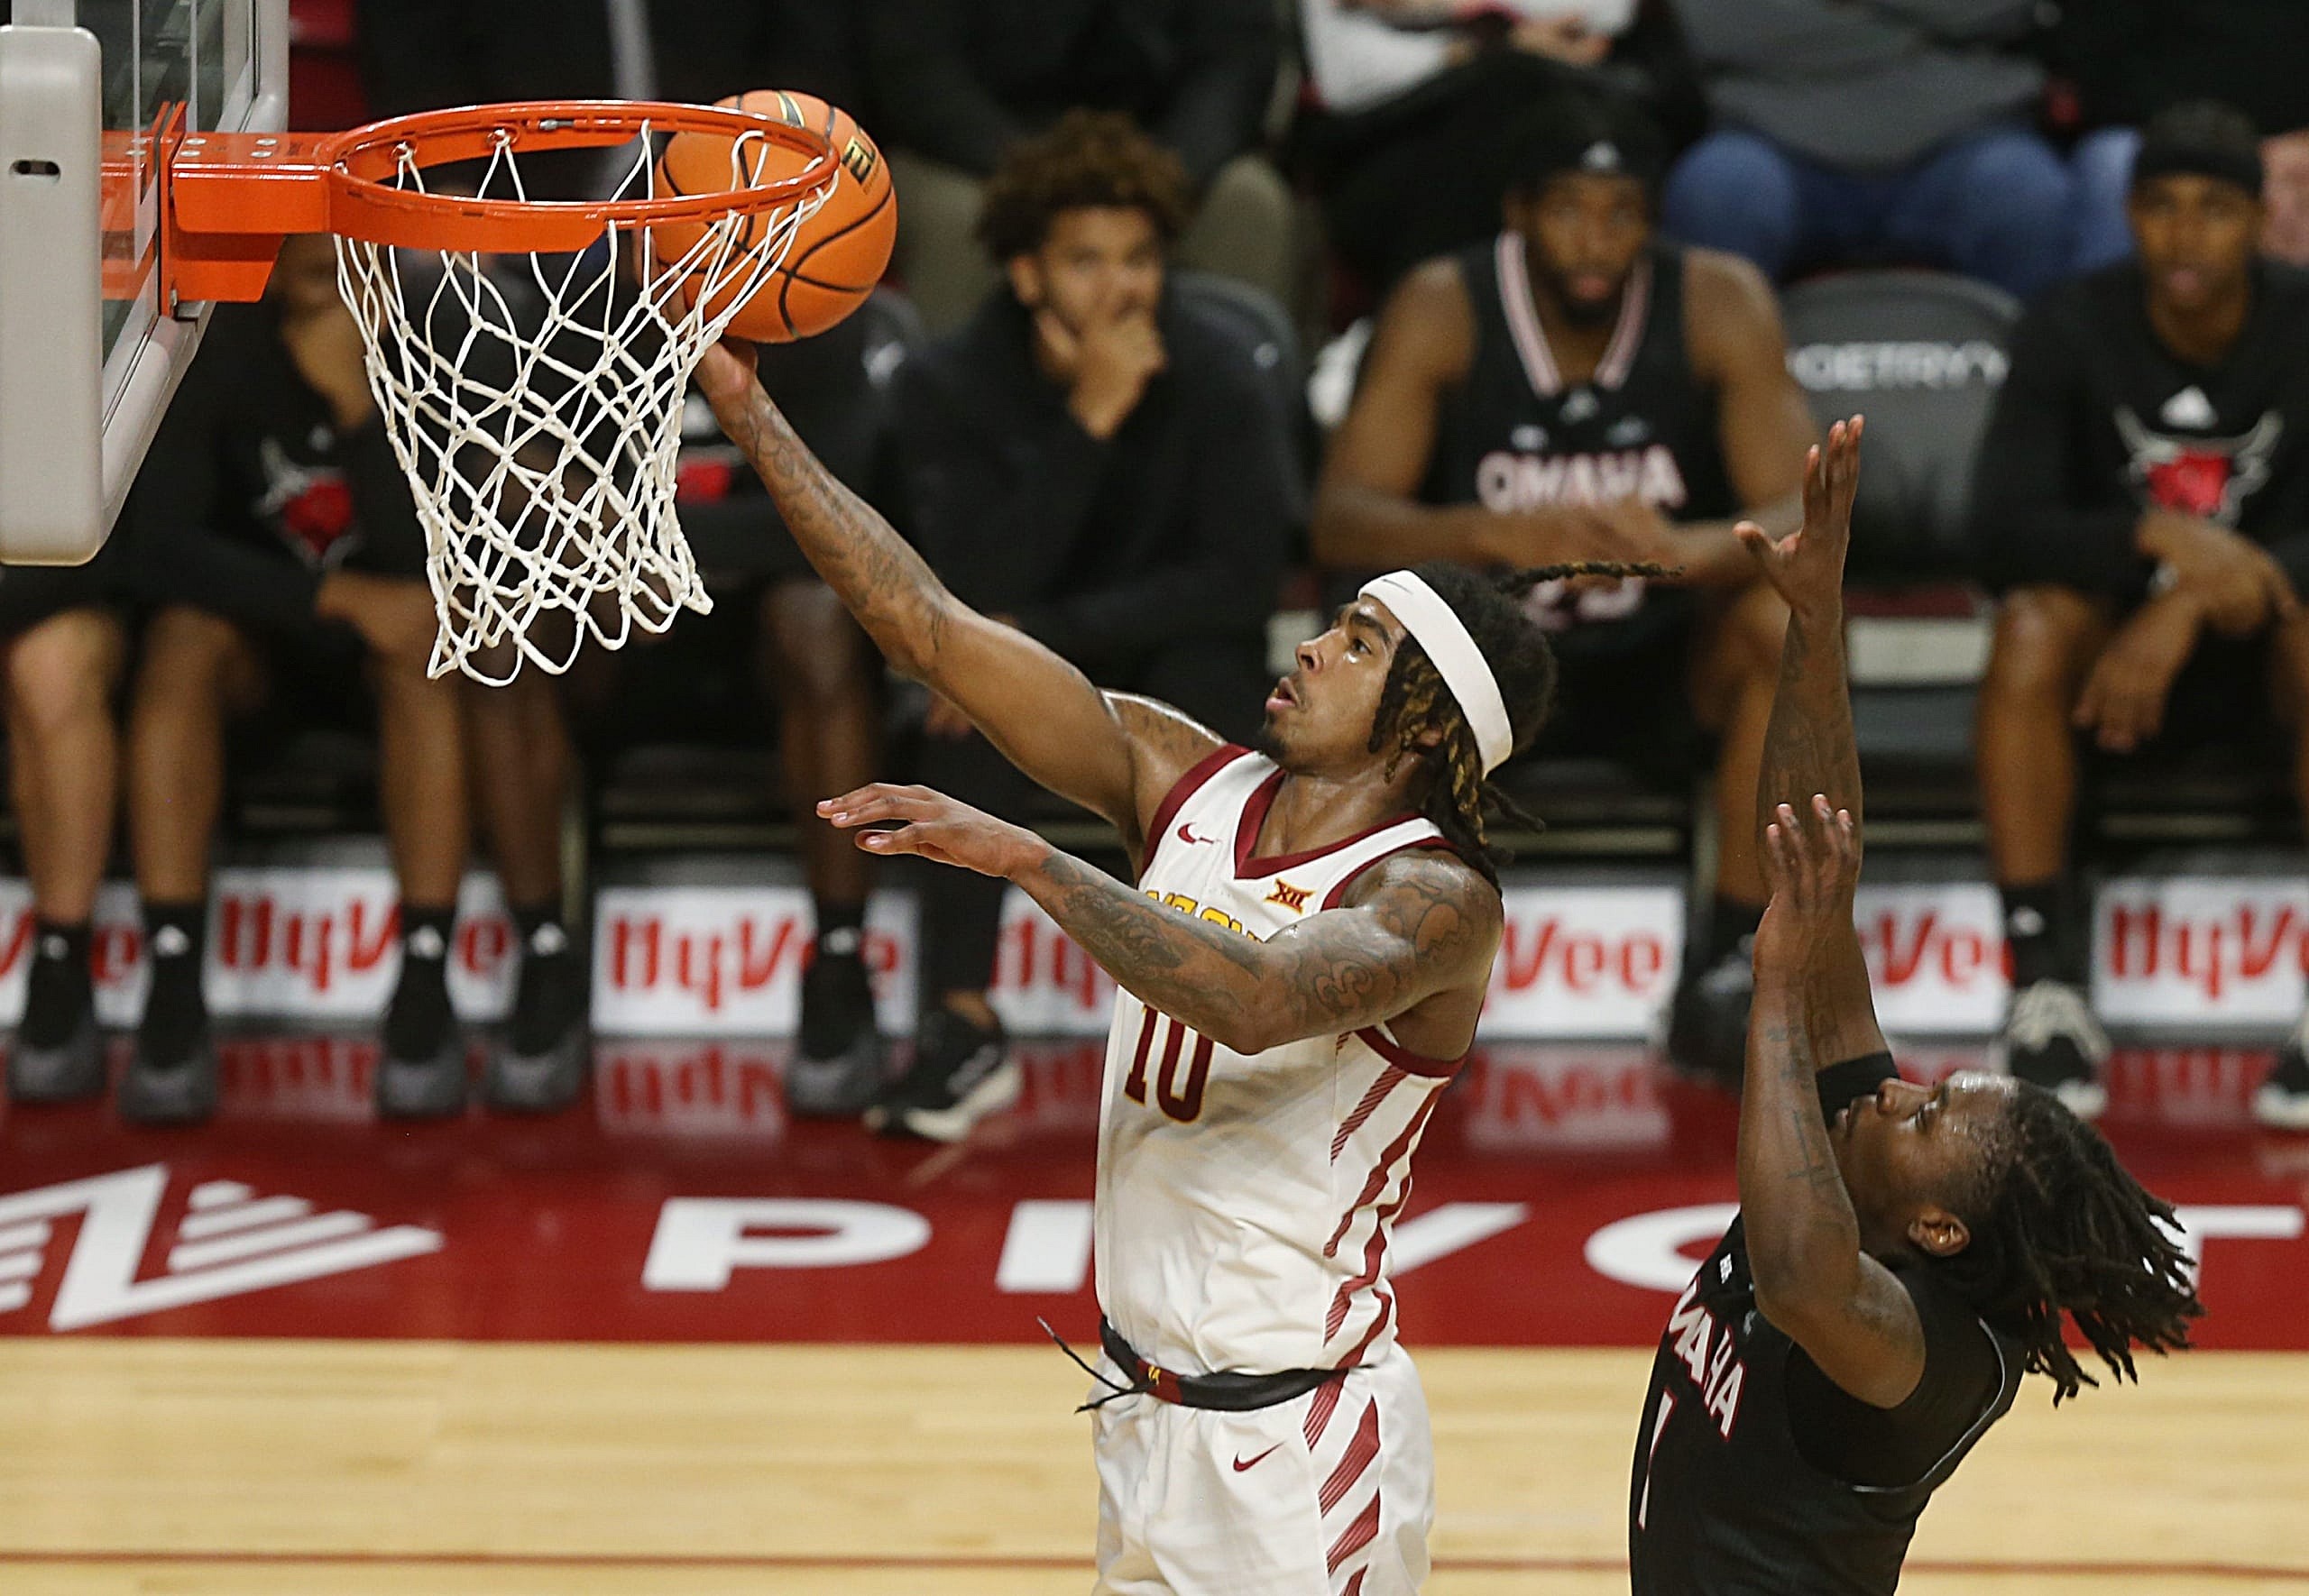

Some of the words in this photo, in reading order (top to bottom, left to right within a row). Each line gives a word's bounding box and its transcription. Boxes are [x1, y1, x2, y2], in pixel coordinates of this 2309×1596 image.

[220, 895, 509, 995] HyVe
[612, 913, 898, 1012] HyVe
[1124, 1003, 1214, 1124] 10
